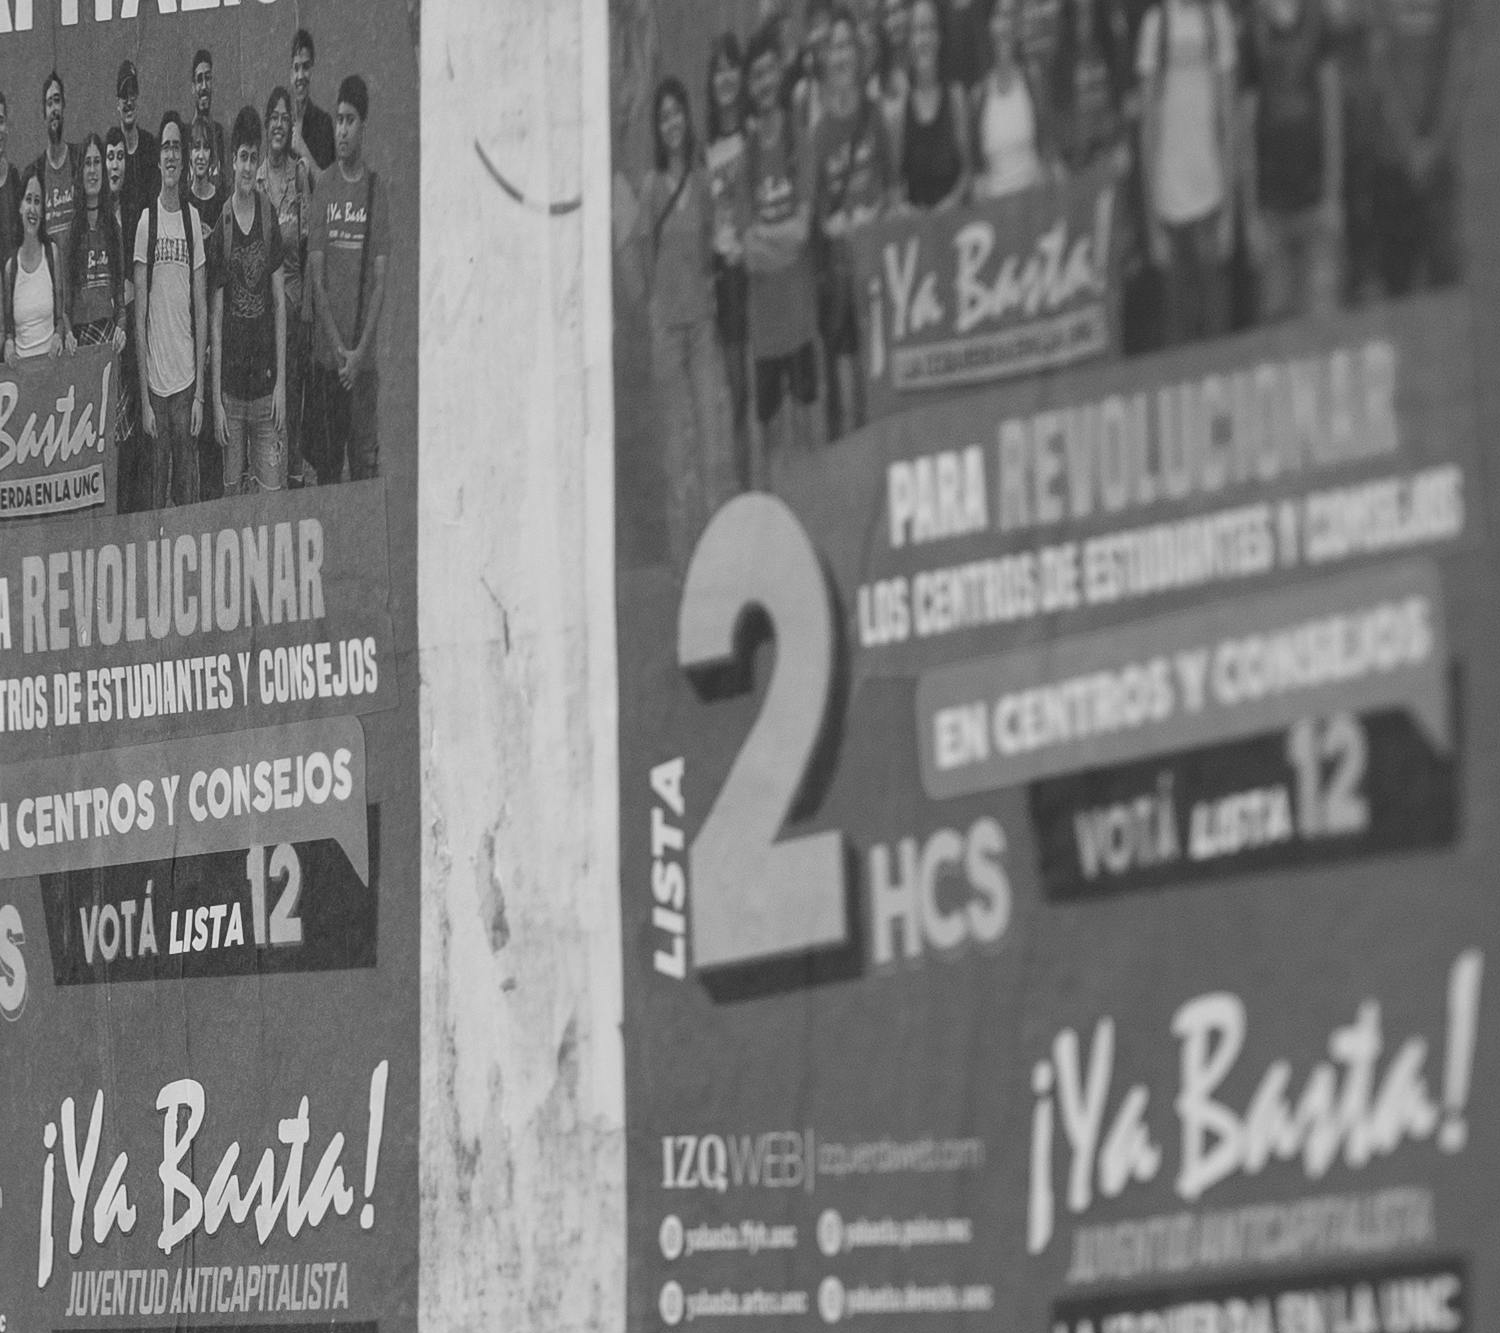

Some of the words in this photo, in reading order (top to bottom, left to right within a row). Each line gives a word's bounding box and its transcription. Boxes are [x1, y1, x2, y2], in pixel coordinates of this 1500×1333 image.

[73, 471, 99, 500] UNC
[886, 443, 987, 548] PARA
[21, 518, 326, 654] REVOLUCIONAR
[53, 671, 82, 726] DE
[86, 652, 234, 723] ESTUDIANTES
[237, 651, 251, 707] Y
[258, 636, 379, 705] CONSEJOS
[677, 490, 846, 971] 2
[934, 706, 987, 772] EN
[996, 668, 1171, 758] CENTROS
[16, 783, 155, 849] CENTROS
[160, 774, 180, 826] Y
[187, 747, 353, 823] CONSEJOS
[1286, 711, 1371, 838] 12
[79, 881, 159, 965] VOTÁ
[169, 901, 244, 955] LISTA
[245, 842, 301, 946] 12
[649, 755, 687, 981] LISTA
[870, 818, 1011, 968] HCS
[1170, 948, 1484, 1202] Basta!
[155, 1060, 388, 1254] Basta!
[65, 1267, 169, 1317] JUVENTUD
[170, 1262, 349, 1313] ANTICAPITALISTA
